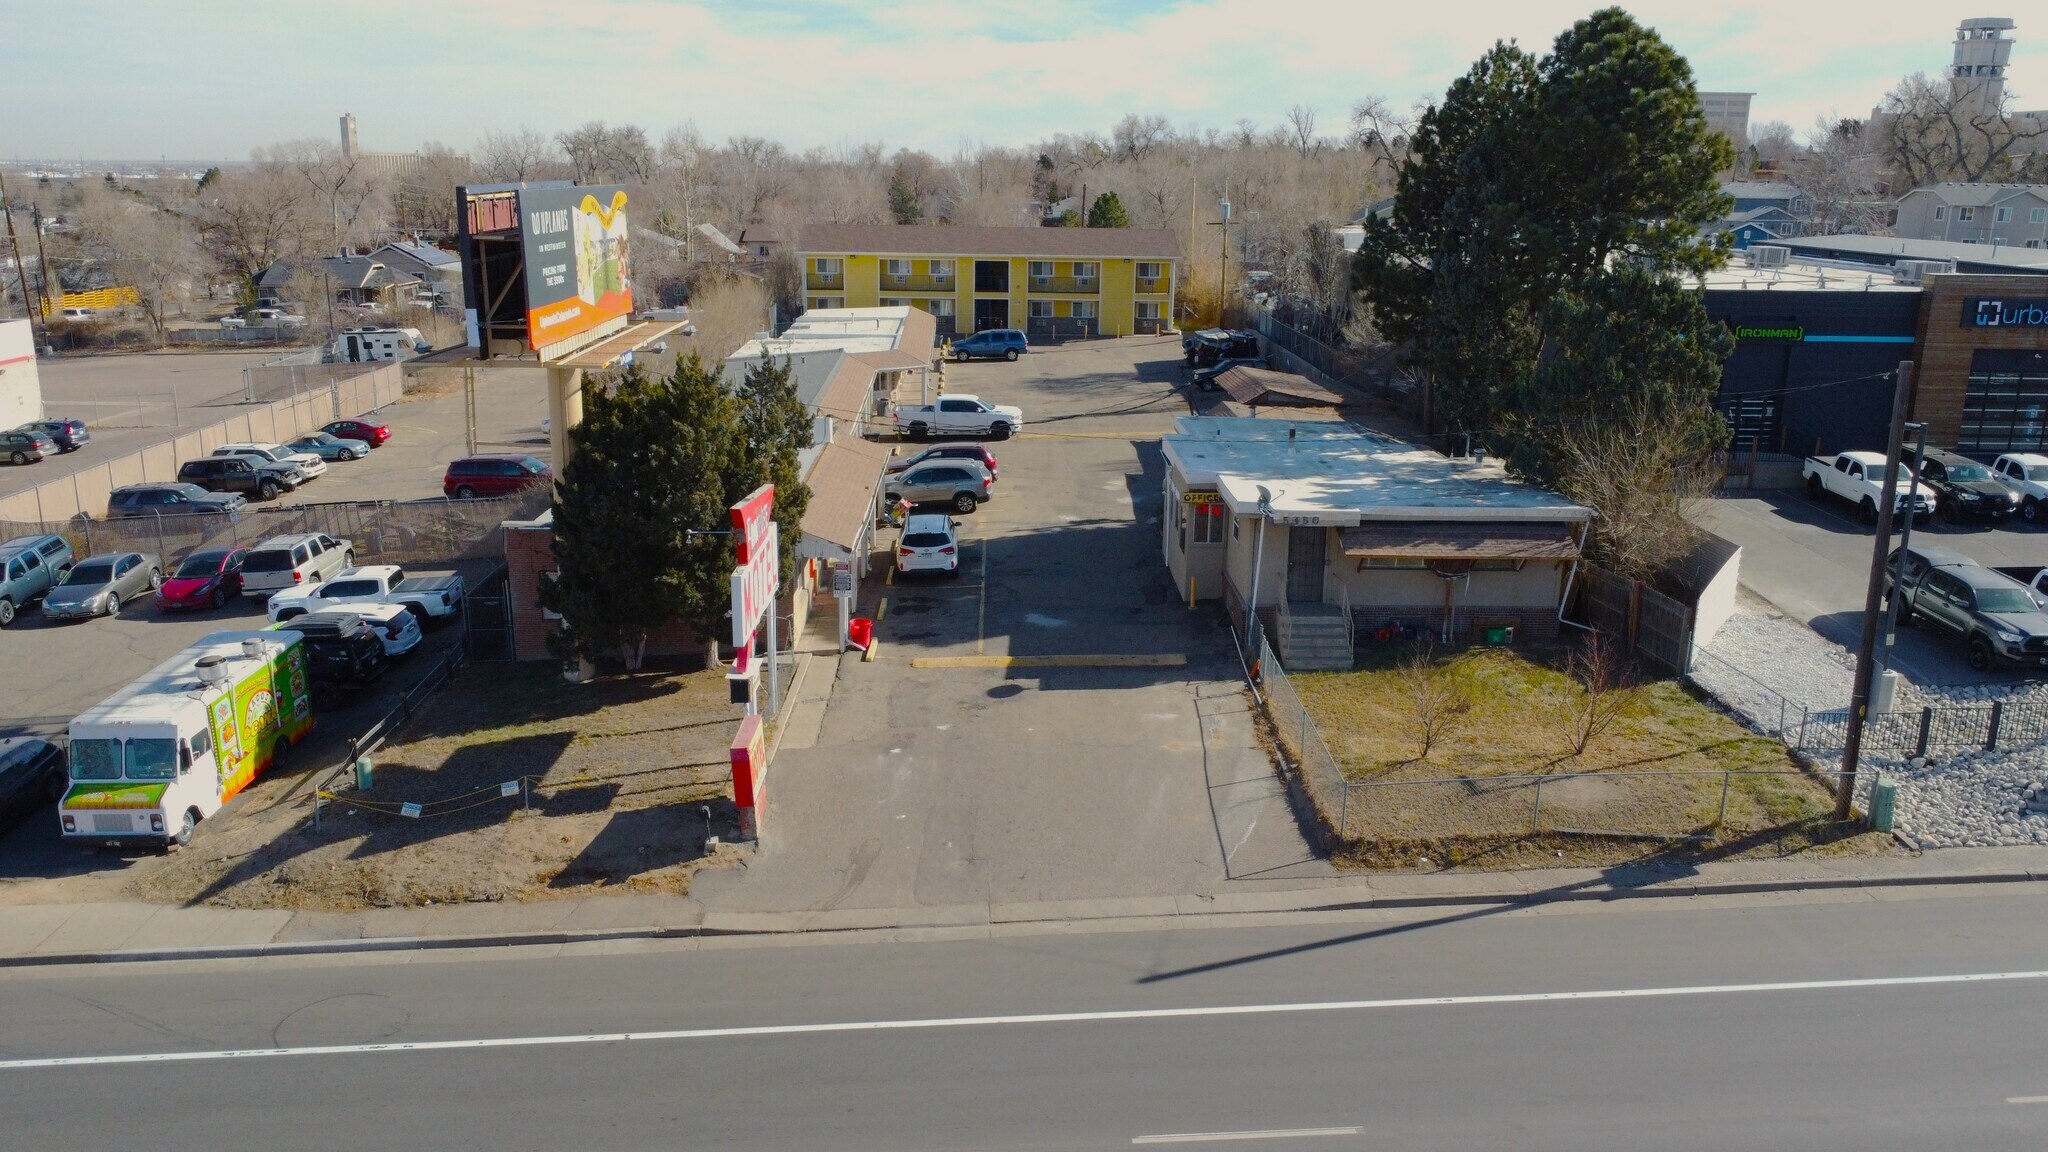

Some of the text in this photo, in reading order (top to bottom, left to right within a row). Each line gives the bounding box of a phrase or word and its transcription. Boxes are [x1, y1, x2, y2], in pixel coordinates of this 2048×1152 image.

[540, 209, 568, 234] UPLANDS
[546, 277, 554, 286] THE
[1740, 328, 1798, 338] IRONMAN
[1184, 494, 1219, 502] OFFICE
[744, 535, 777, 637] MOTEL
